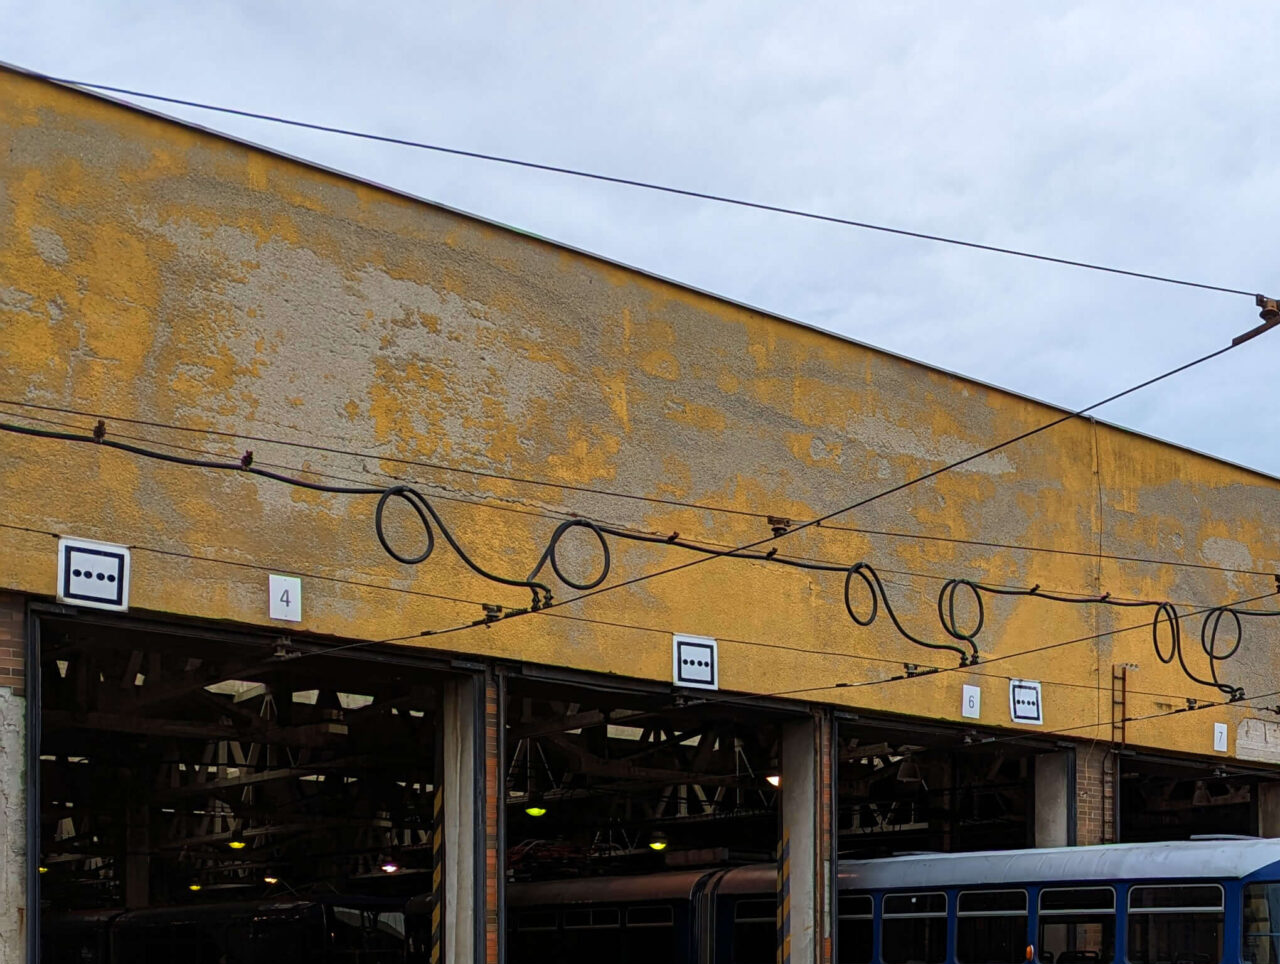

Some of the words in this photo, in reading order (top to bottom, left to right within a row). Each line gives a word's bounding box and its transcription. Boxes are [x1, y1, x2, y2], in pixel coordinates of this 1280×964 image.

[279, 588, 291, 608] 4
[968, 695, 975, 710] 6
[1217, 731, 1224, 745] 7
